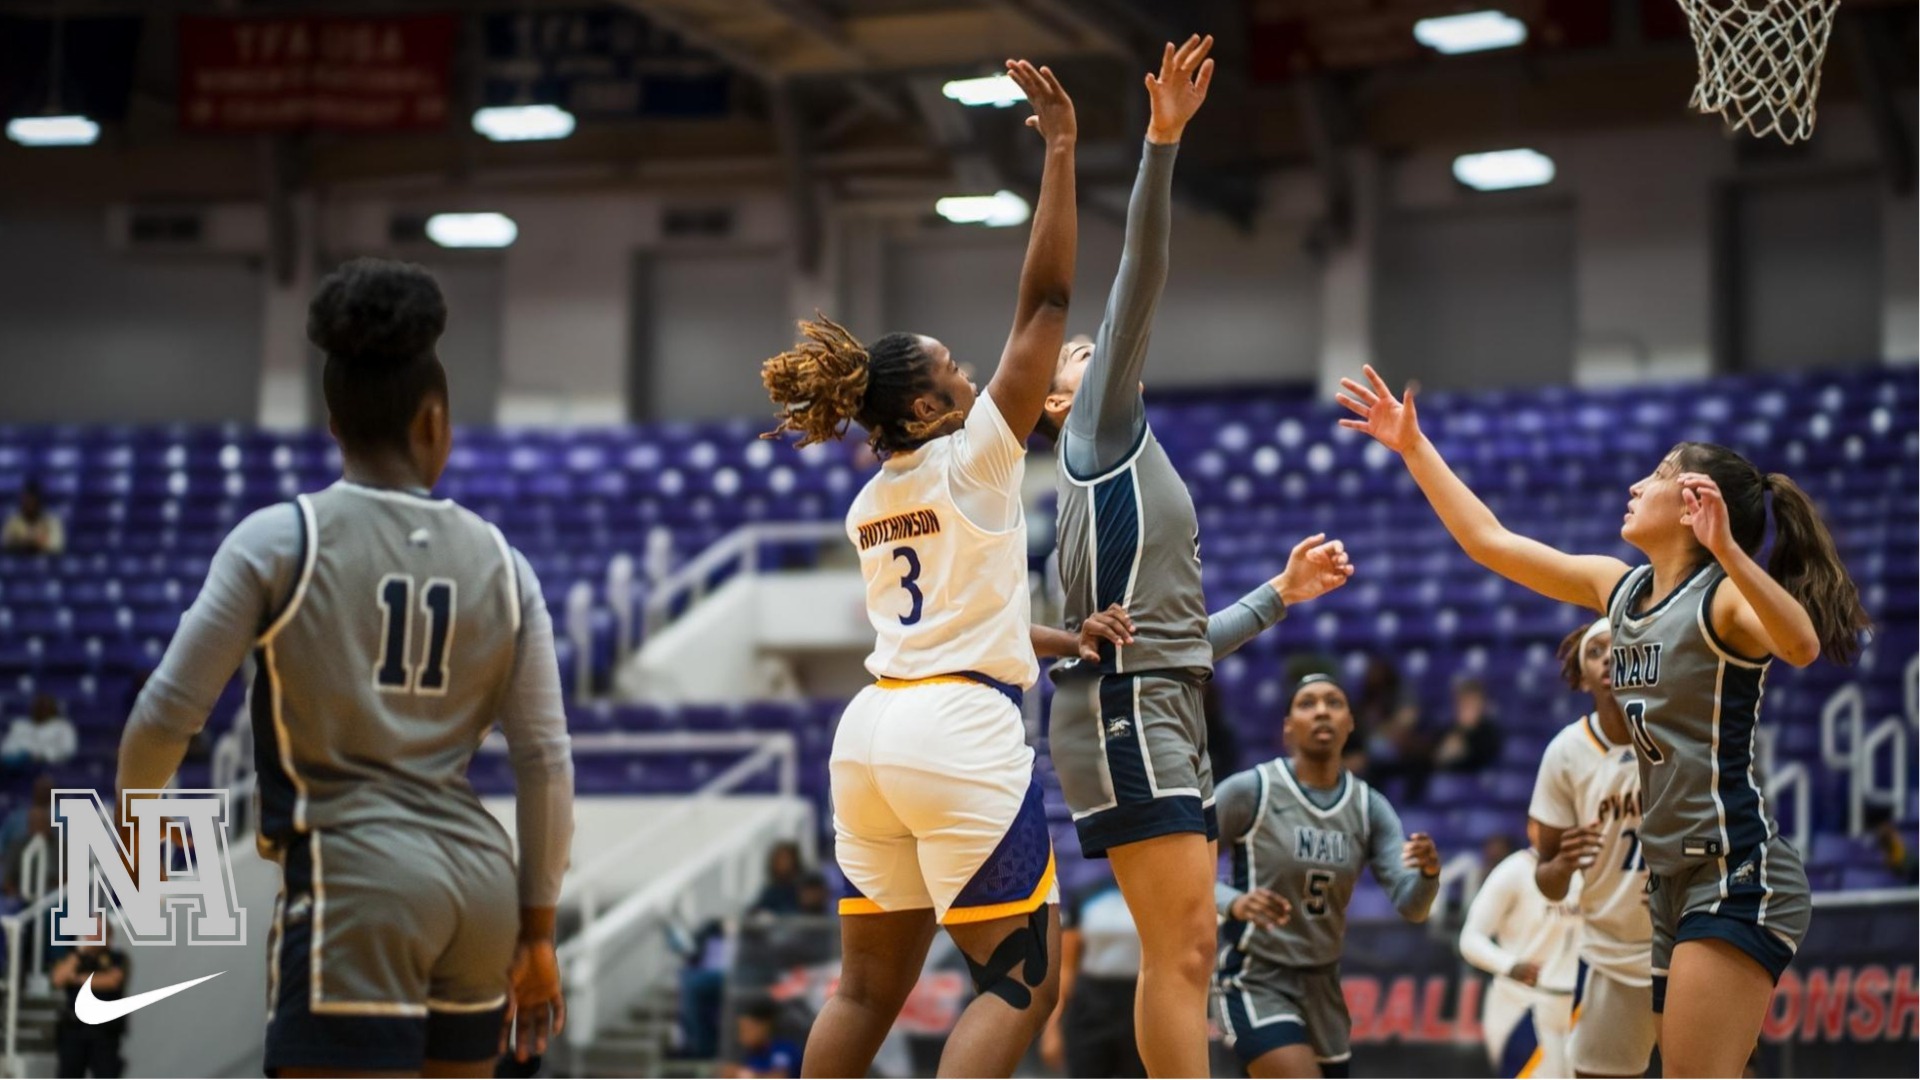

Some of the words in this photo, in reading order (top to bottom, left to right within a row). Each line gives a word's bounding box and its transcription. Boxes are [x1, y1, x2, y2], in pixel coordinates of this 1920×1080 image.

[857, 508, 941, 551] HUTCHINSON
[892, 546, 924, 626] 3
[372, 572, 458, 697] 11
[1612, 642, 1663, 690] NAU
[1293, 825, 1350, 864] NAU
[1302, 868, 1337, 921] 5
